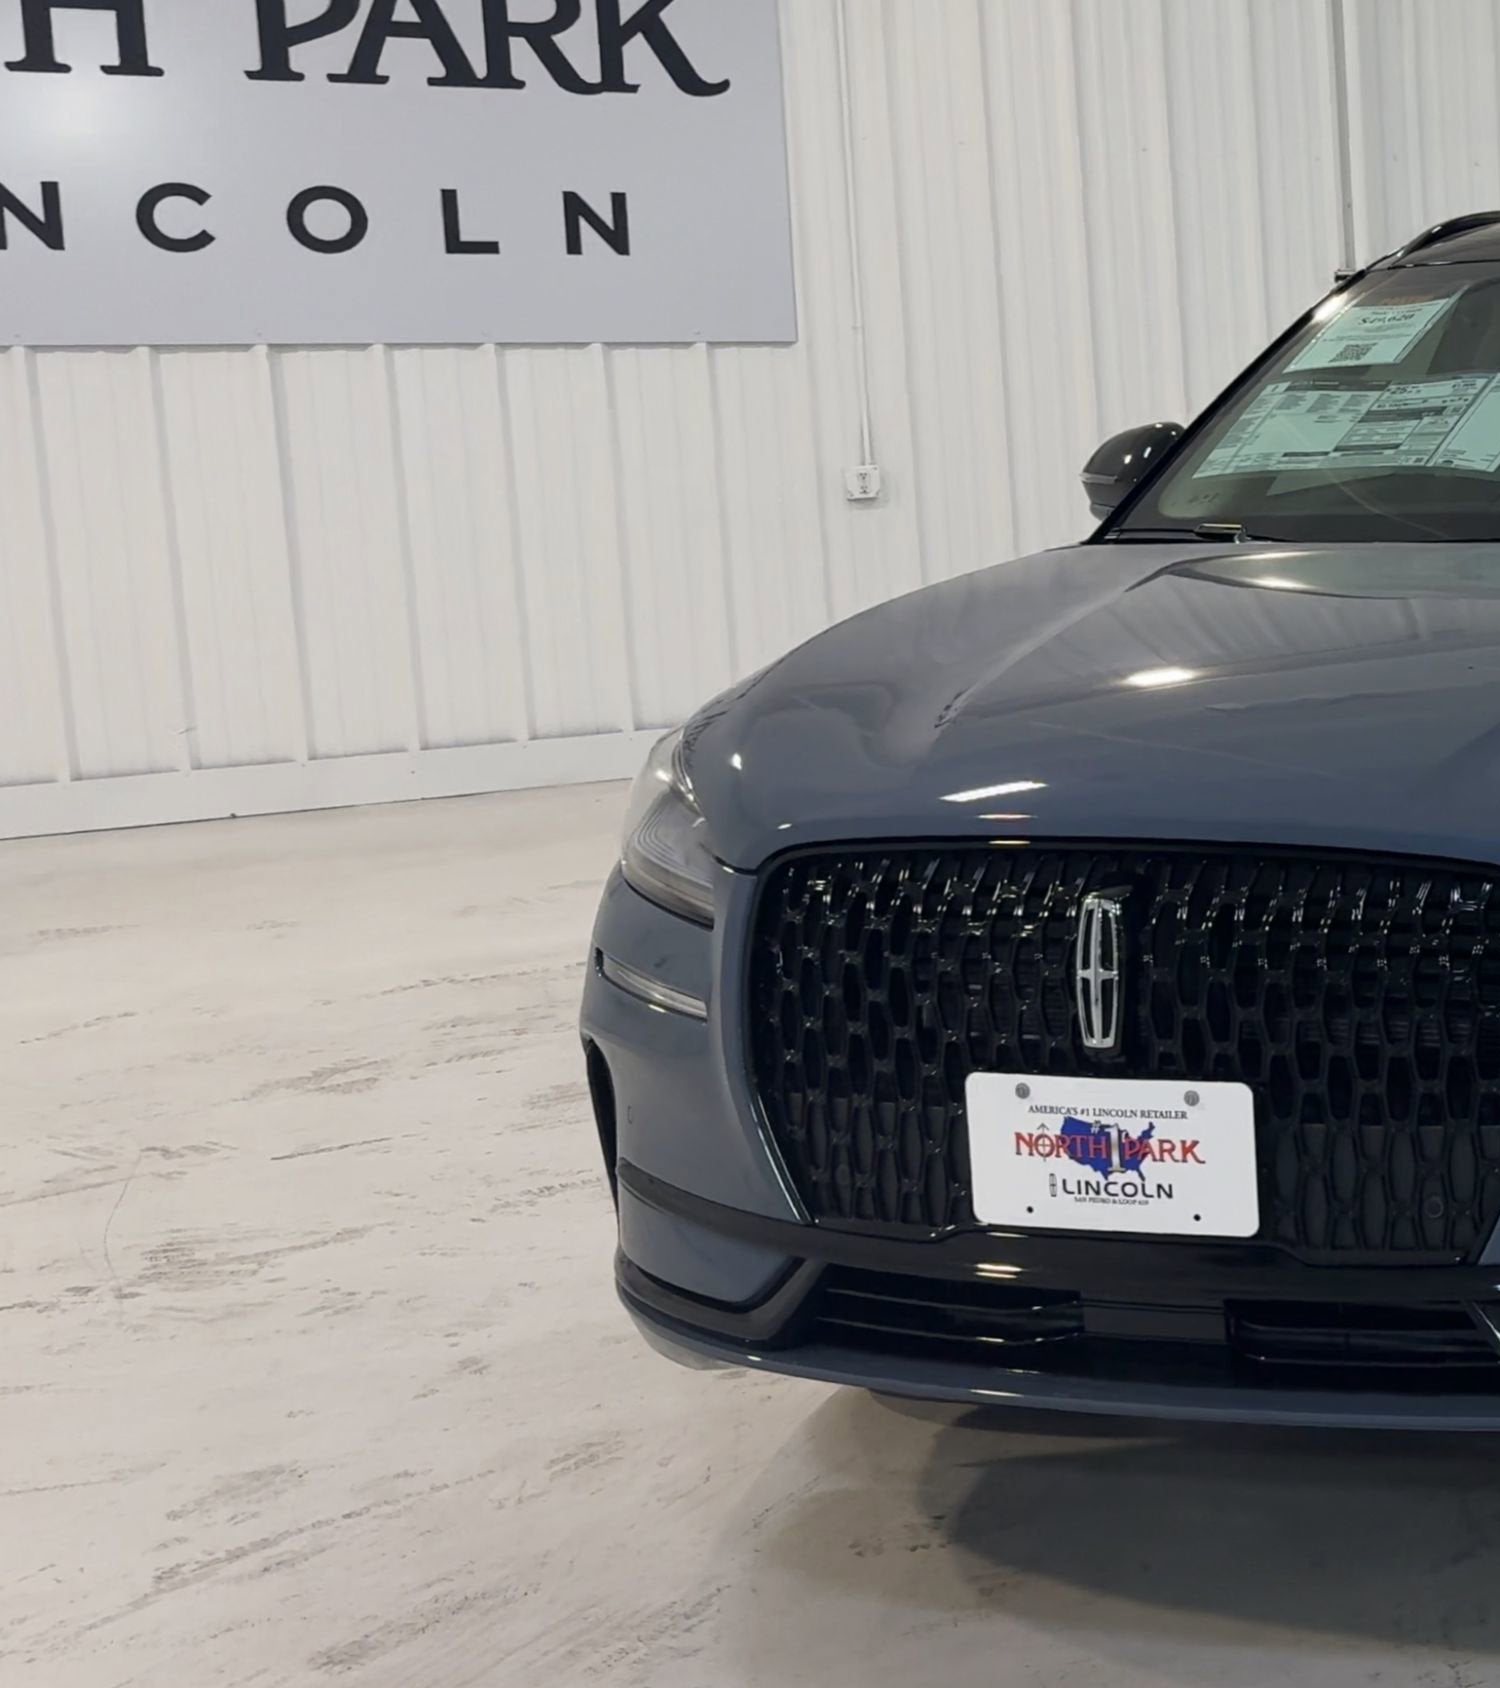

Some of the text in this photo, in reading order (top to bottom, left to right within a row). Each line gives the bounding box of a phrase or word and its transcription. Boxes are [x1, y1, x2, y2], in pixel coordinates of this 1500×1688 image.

[244, 0, 731, 97] PARK
[1028, 1105, 1078, 1117] AMERICA'S
[1092, 1108, 1138, 1118] LINCOLN
[1140, 1109, 1188, 1120] RETAILER
[1014, 1131, 1205, 1163] NORTH PARK
[1061, 1178, 1173, 1199] LINCOLN
